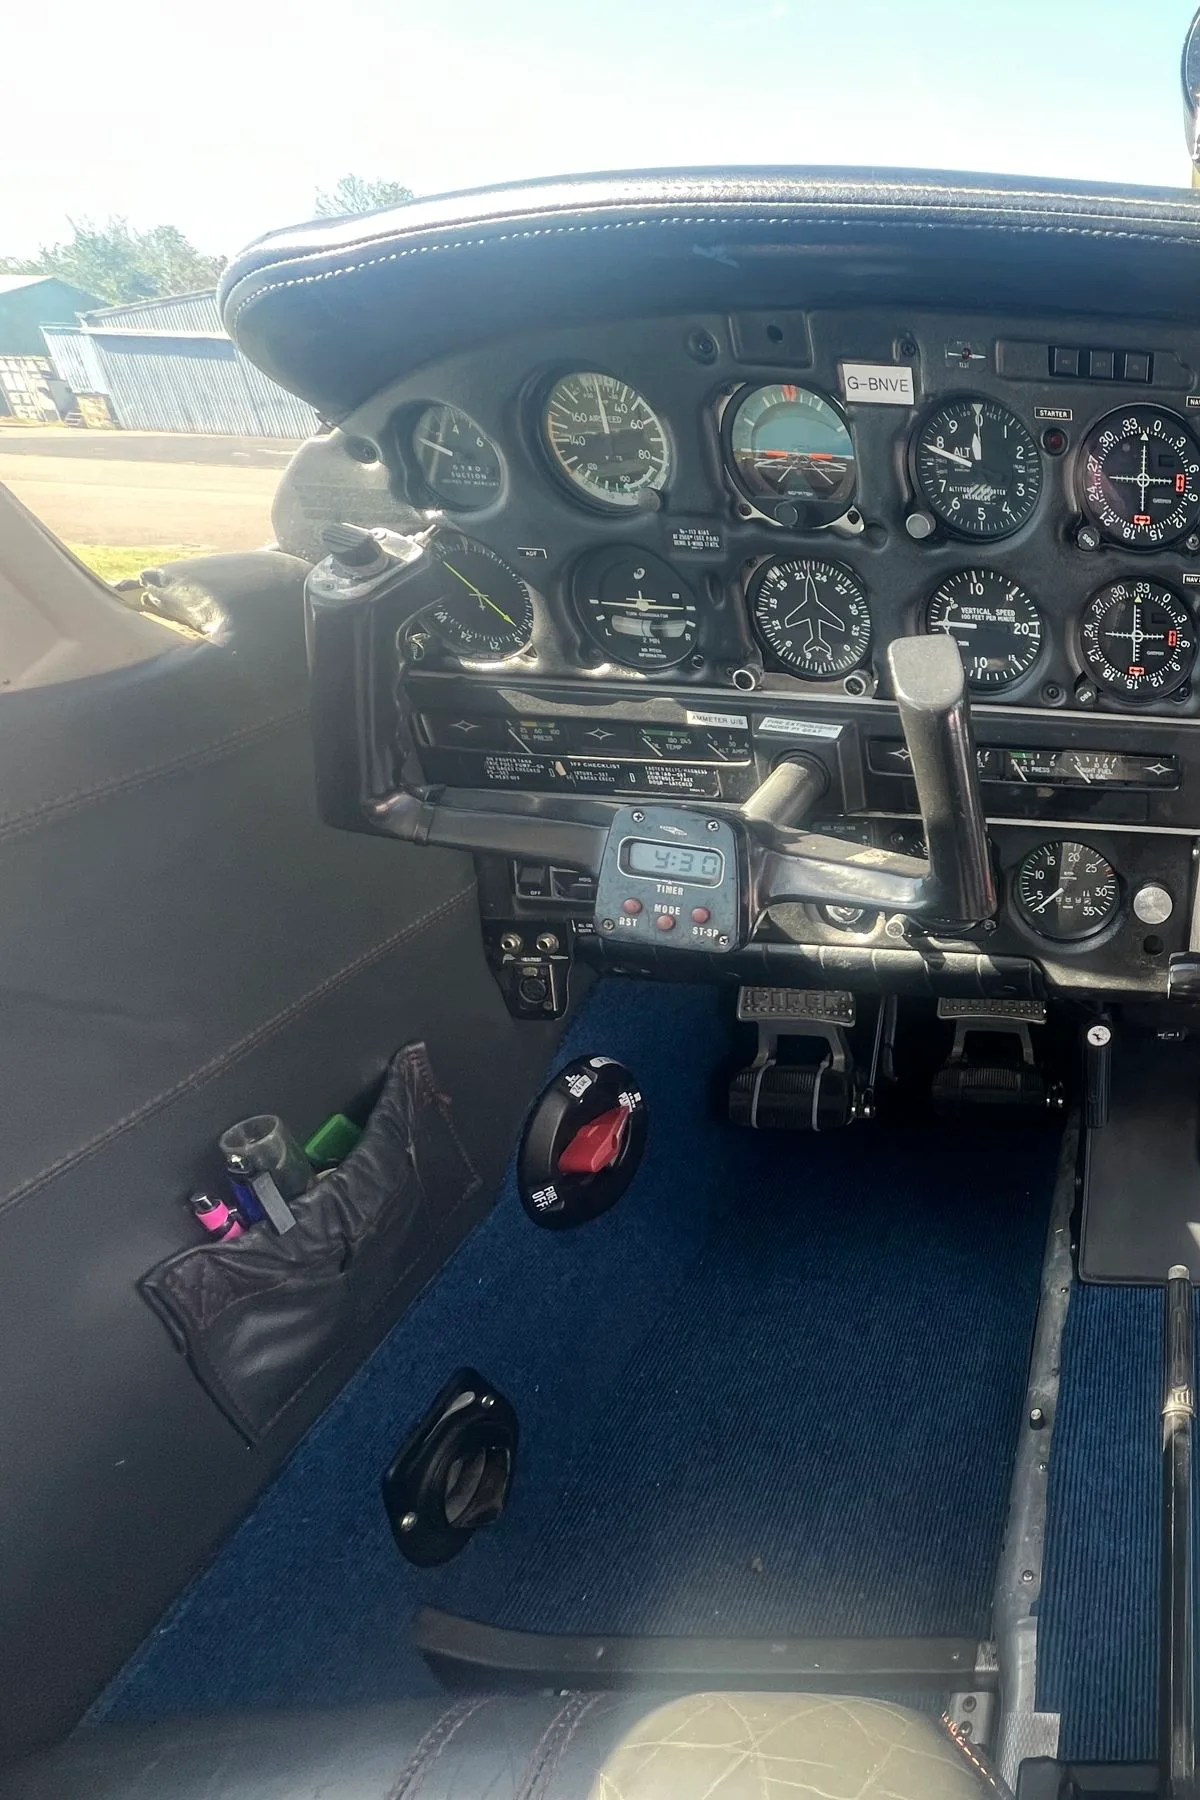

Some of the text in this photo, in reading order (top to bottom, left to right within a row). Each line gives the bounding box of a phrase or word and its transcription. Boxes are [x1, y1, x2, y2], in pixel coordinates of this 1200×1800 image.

[847, 376, 909, 393] G-BNVE
[614, 403, 628, 414] 40
[1039, 409, 1067, 418] STARTER
[571, 413, 588, 423] 160
[975, 413, 984, 427] 0
[452, 424, 460, 435] 4
[630, 420, 645, 430] 60
[948, 420, 958, 434] 9
[1122, 418, 1138, 432] 33
[1153, 420, 1162, 432] 0
[1004, 424, 1008, 439] 1
[476, 437, 484, 448] 6
[570, 436, 586, 446] 140
[936, 436, 945, 449] 8
[1099, 431, 1114, 447] 30
[1176, 437, 1186, 448] 3
[638, 449, 651, 459] 80
[953, 447, 971, 458] ALT
[1016, 446, 1024, 460] 2
[1087, 454, 1099, 473] 27
[1189, 464, 1199, 473] 6
[451, 471, 487, 479] SUCTION
[938, 480, 947, 493] 7
[1016, 483, 1025, 497] 3
[1087, 486, 1100, 502] 24
[1188, 493, 1198, 502] 9
[951, 497, 961, 510] 6
[1002, 501, 1012, 514] 4
[977, 507, 986, 521] 5
[1099, 511, 1115, 526] 21
[1172, 514, 1187, 529] 12
[1122, 527, 1136, 540] 18
[1149, 529, 1164, 541] 15
[794, 572, 805, 580] 21
[815, 572, 828, 583] 24
[776, 580, 788, 591] 18
[834, 584, 848, 595] 27
[970, 582, 984, 595] 10
[1111, 584, 1126, 598] 30
[1136, 582, 1150, 593] 33
[769, 598, 778, 609] 15
[1162, 593, 1172, 603] 0
[849, 603, 859, 615] 30
[961, 607, 991, 615] VERTICAL
[1091, 599, 1105, 614] 27
[434, 611, 448, 623] W
[1177, 614, 1188, 623] 3
[771, 619, 782, 631] 12
[851, 624, 859, 636] 33
[1014, 622, 1029, 635] 20
[1083, 623, 1094, 637] 24
[460, 630, 473, 642] 24
[605, 627, 612, 636] L
[684, 633, 691, 641] R
[514, 636, 525, 647] S
[1181, 640, 1191, 648] 6
[843, 644, 851, 652] 0
[1087, 649, 1100, 662] 21
[974, 656, 988, 668] 10
[1171, 662, 1181, 671] 9
[1102, 668, 1115, 681] 18
[1126, 679, 1139, 690] 15
[1151, 675, 1165, 688] 12
[692, 715, 729, 724] AMMETER
[1047, 856, 1056, 866] 15
[1068, 853, 1080, 862] 20
[1085, 864, 1097, 873] 25
[1035, 870, 1045, 879] 10
[656, 884, 684, 896] TIMER
[1036, 890, 1043, 899] 5
[1094, 888, 1107, 896] 30
[654, 904, 681, 915] MODE
[1082, 907, 1095, 916] 35
[618, 916, 637, 927] RST
[543, 1185, 559, 1204] FUEL
[531, 1190, 549, 1212] OFF
